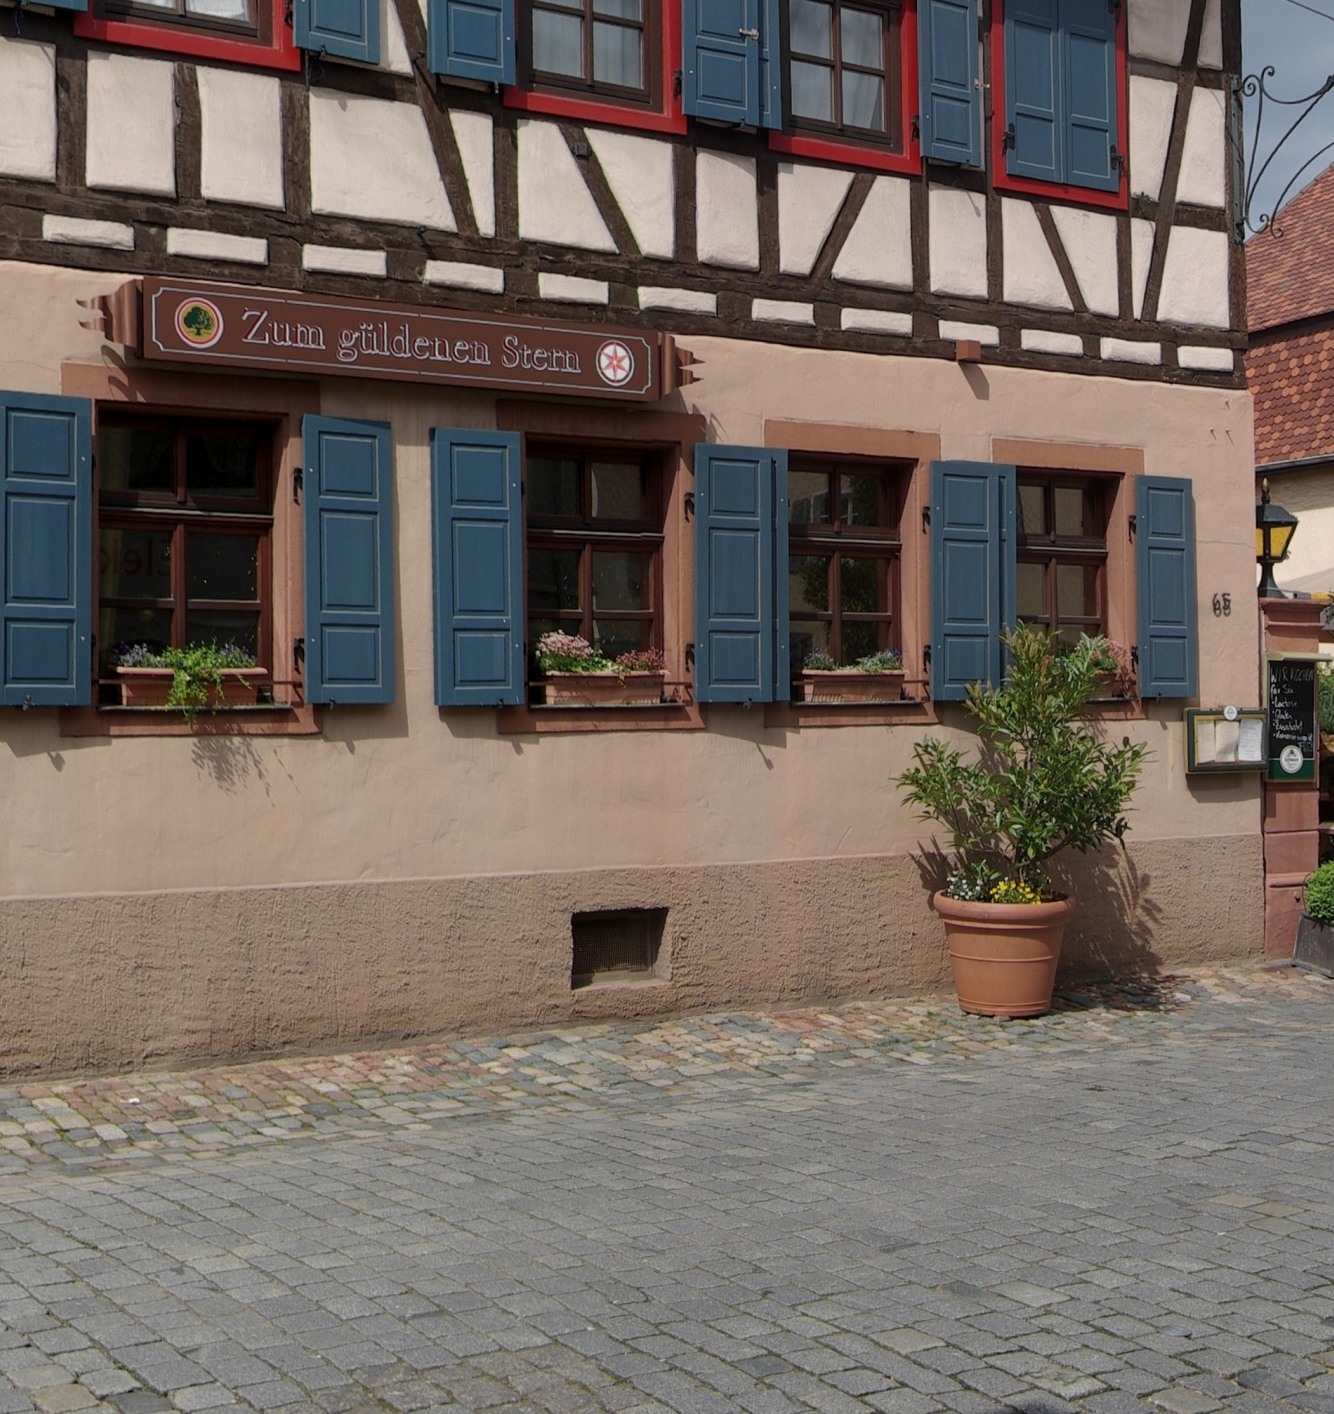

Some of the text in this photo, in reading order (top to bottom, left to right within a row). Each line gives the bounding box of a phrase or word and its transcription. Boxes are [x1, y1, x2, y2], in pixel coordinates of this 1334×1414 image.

[241, 306, 582, 374] Zum güldenen Stern
[1212, 592, 1231, 610] 65
